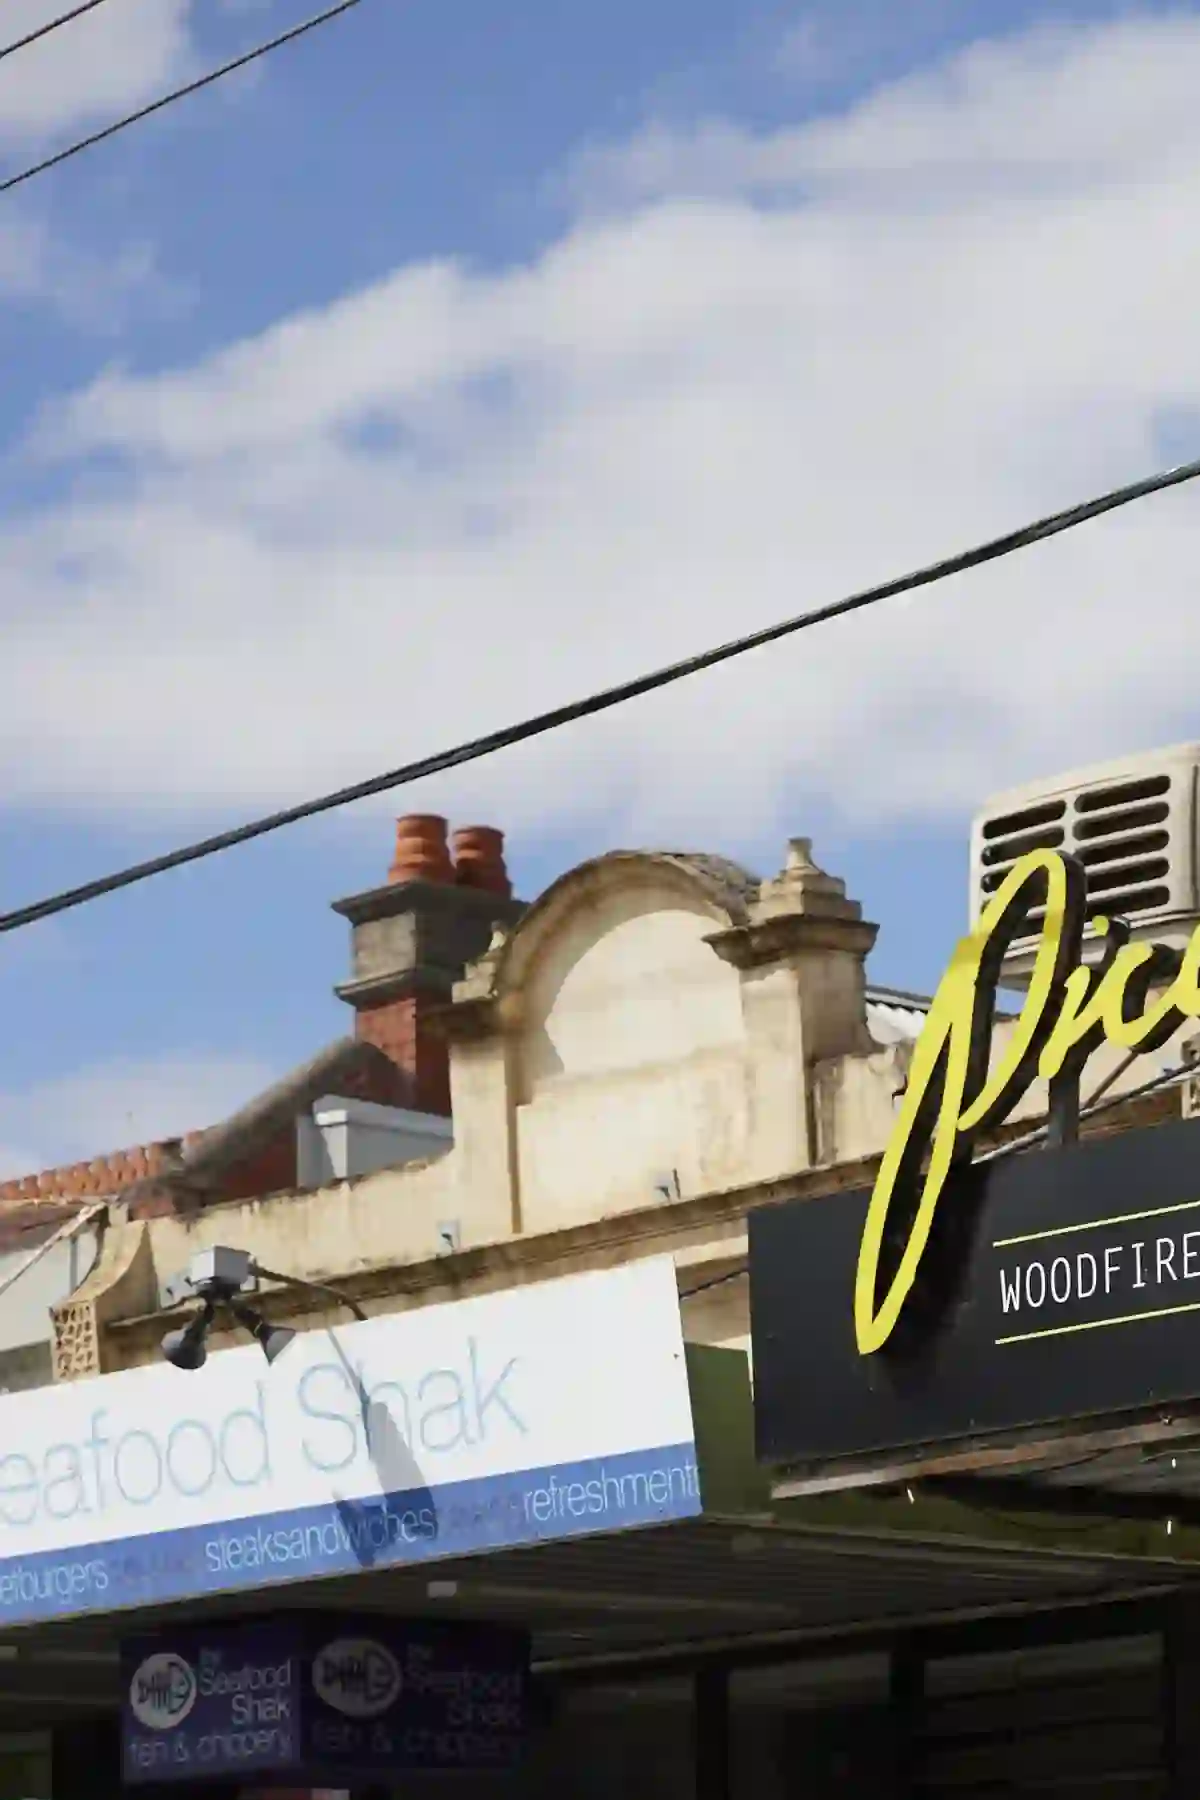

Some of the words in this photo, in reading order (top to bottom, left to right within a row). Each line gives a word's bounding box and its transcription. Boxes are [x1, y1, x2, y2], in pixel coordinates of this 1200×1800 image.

[299, 1335, 530, 1473] Shak
[200, 1658, 292, 1696] Seafood
[231, 1693, 291, 1725] Shak
